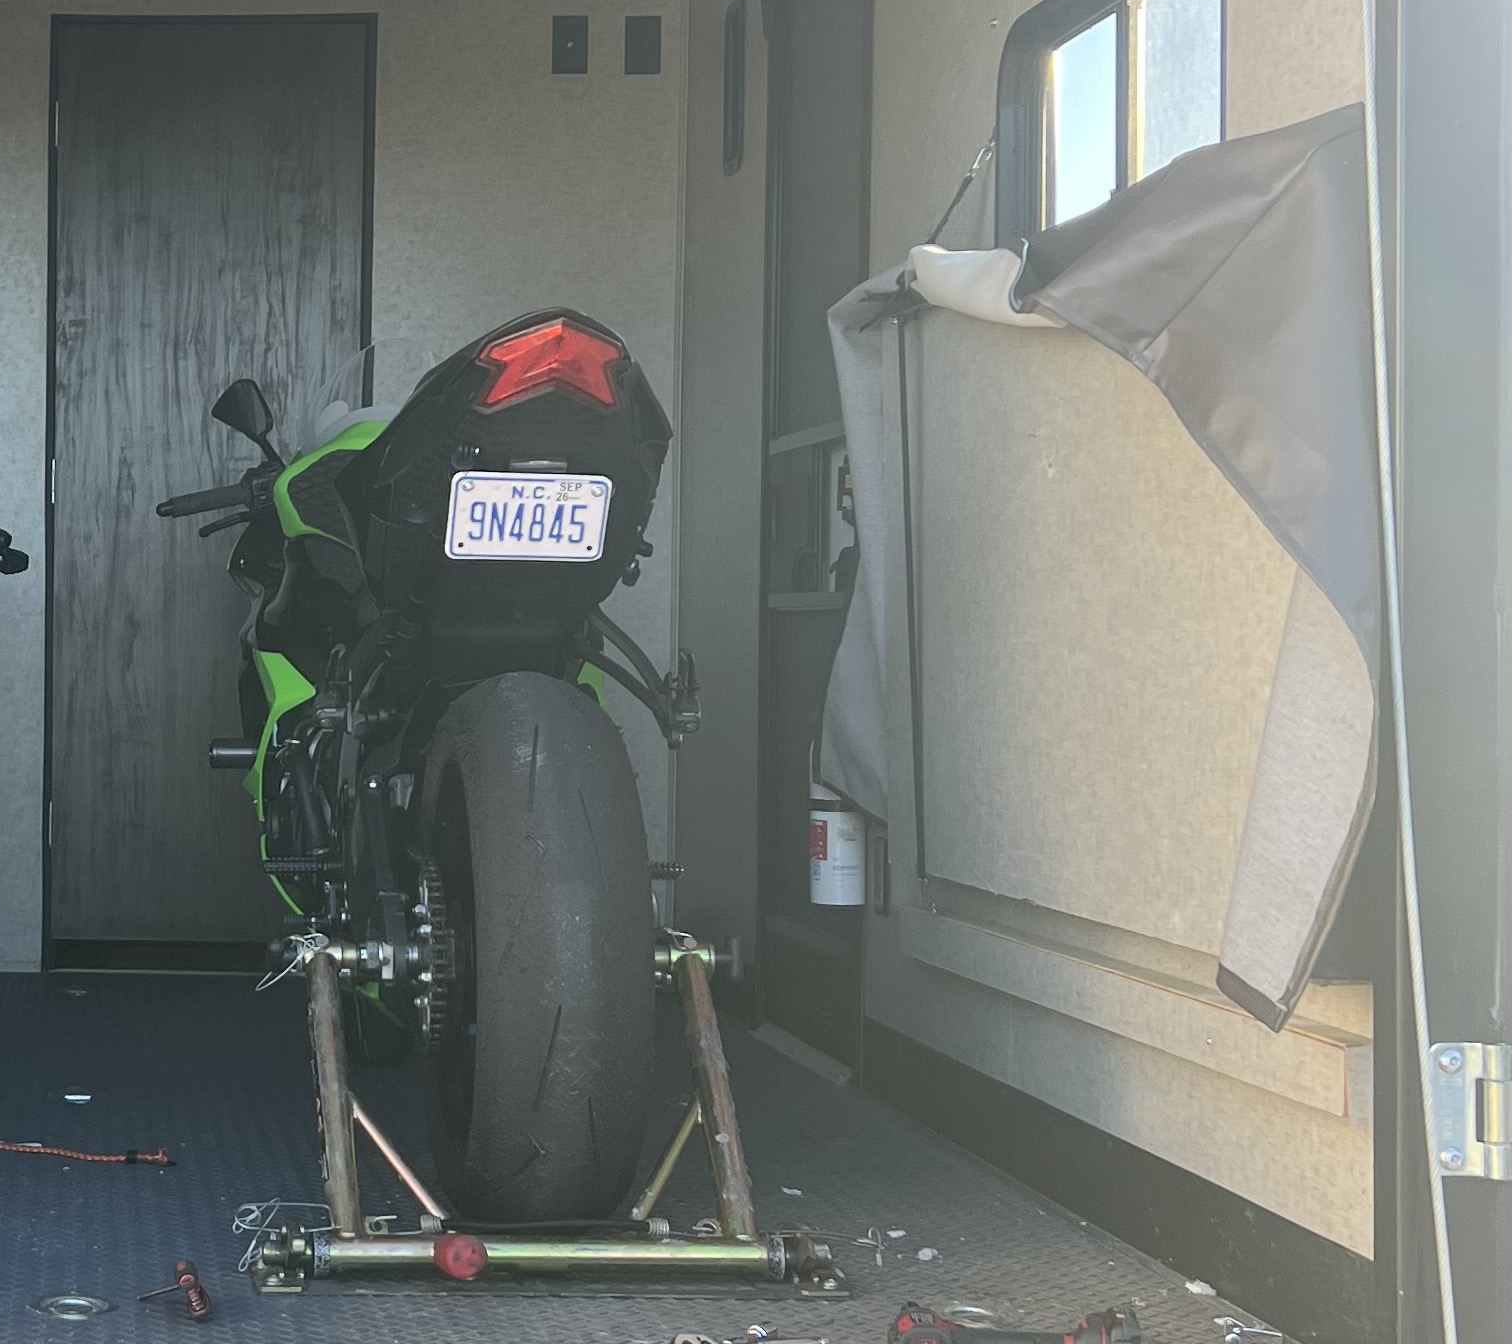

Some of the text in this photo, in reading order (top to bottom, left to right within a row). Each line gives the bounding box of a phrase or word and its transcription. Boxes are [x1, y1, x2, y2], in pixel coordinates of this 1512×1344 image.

[511, 481, 582, 501] N.C. SEP
[468, 501, 588, 544] 9N4845
